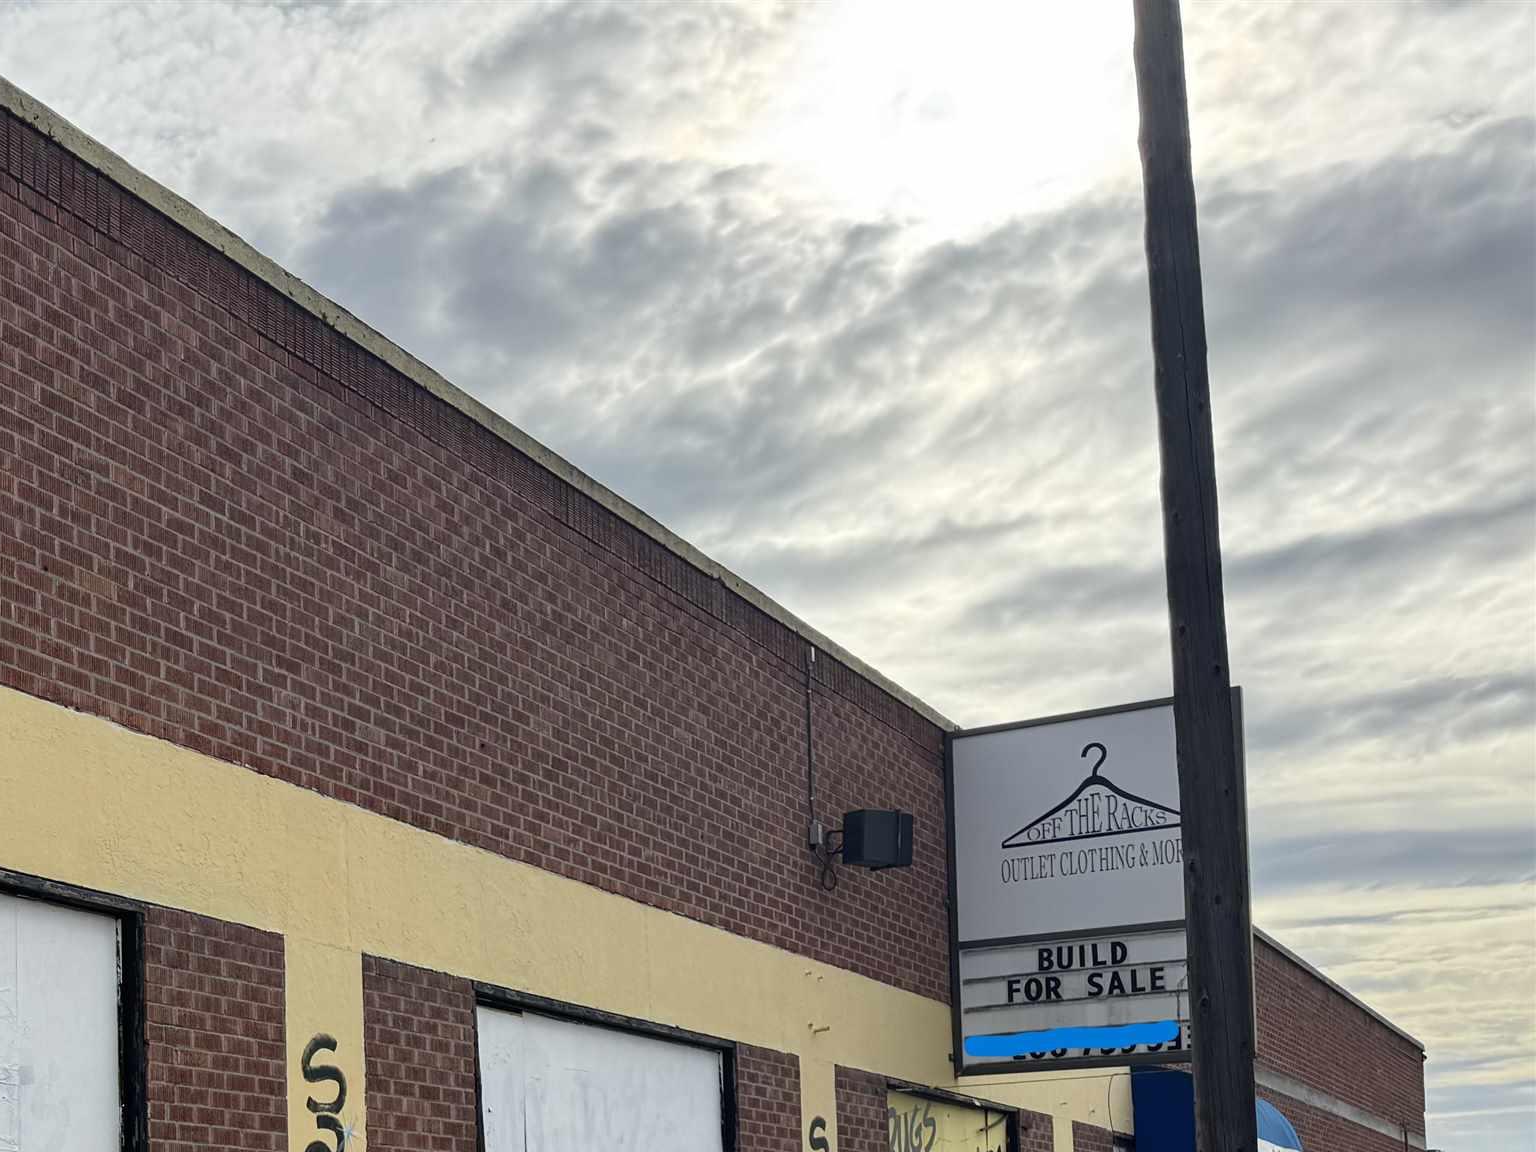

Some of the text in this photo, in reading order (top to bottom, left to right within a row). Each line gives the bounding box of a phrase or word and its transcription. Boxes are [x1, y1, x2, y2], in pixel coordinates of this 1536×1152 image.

[1027, 792, 1168, 841] OFF THE RACKS
[1001, 853, 1056, 883] OUTLET
[1060, 843, 1135, 876] CLOTHING
[1139, 842, 1149, 867] &
[1038, 941, 1128, 971] BUILD
[1007, 967, 1165, 1003] FOR SALE
